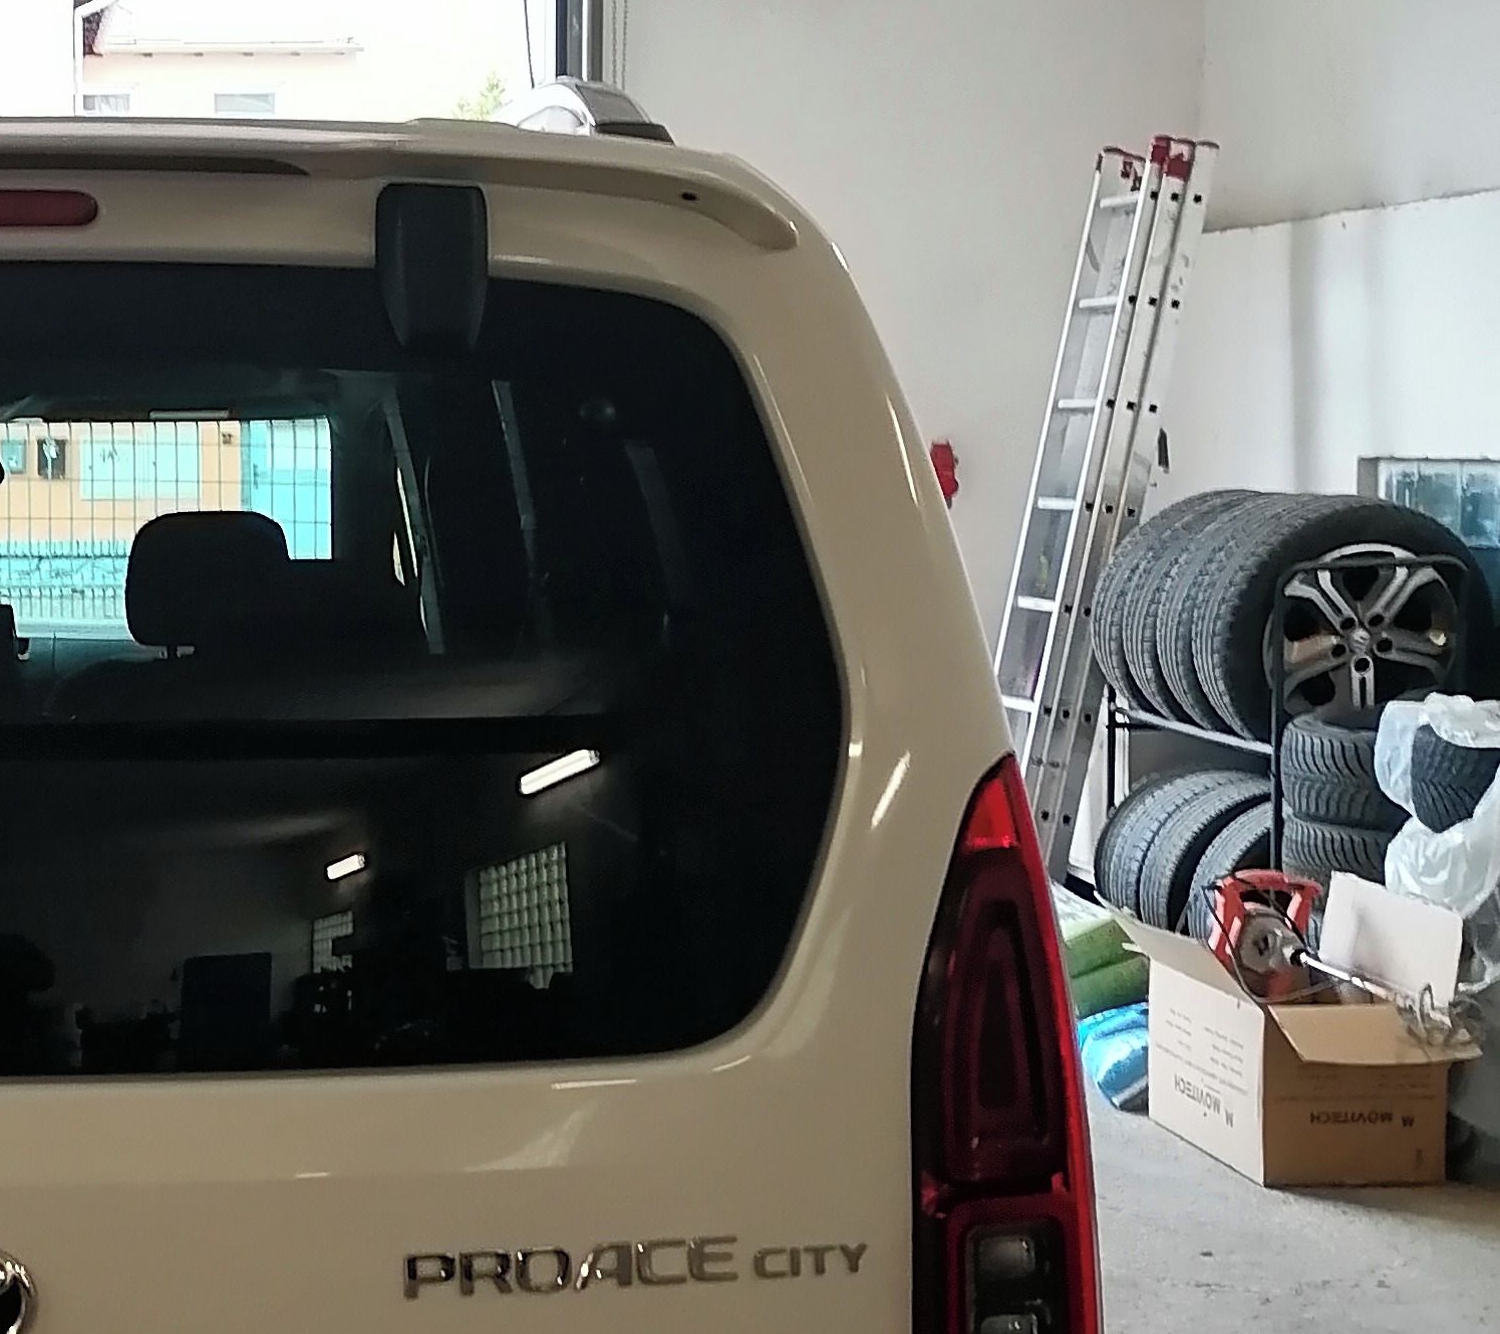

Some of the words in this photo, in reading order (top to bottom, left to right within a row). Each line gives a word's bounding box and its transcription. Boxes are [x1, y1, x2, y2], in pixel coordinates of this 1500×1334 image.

[1173, 1073, 1221, 1115] MOVITECH
[1309, 1109, 1394, 1125] MOVITECH
[403, 1235, 739, 1299] PROACE
[752, 1243, 868, 1279] CITY
